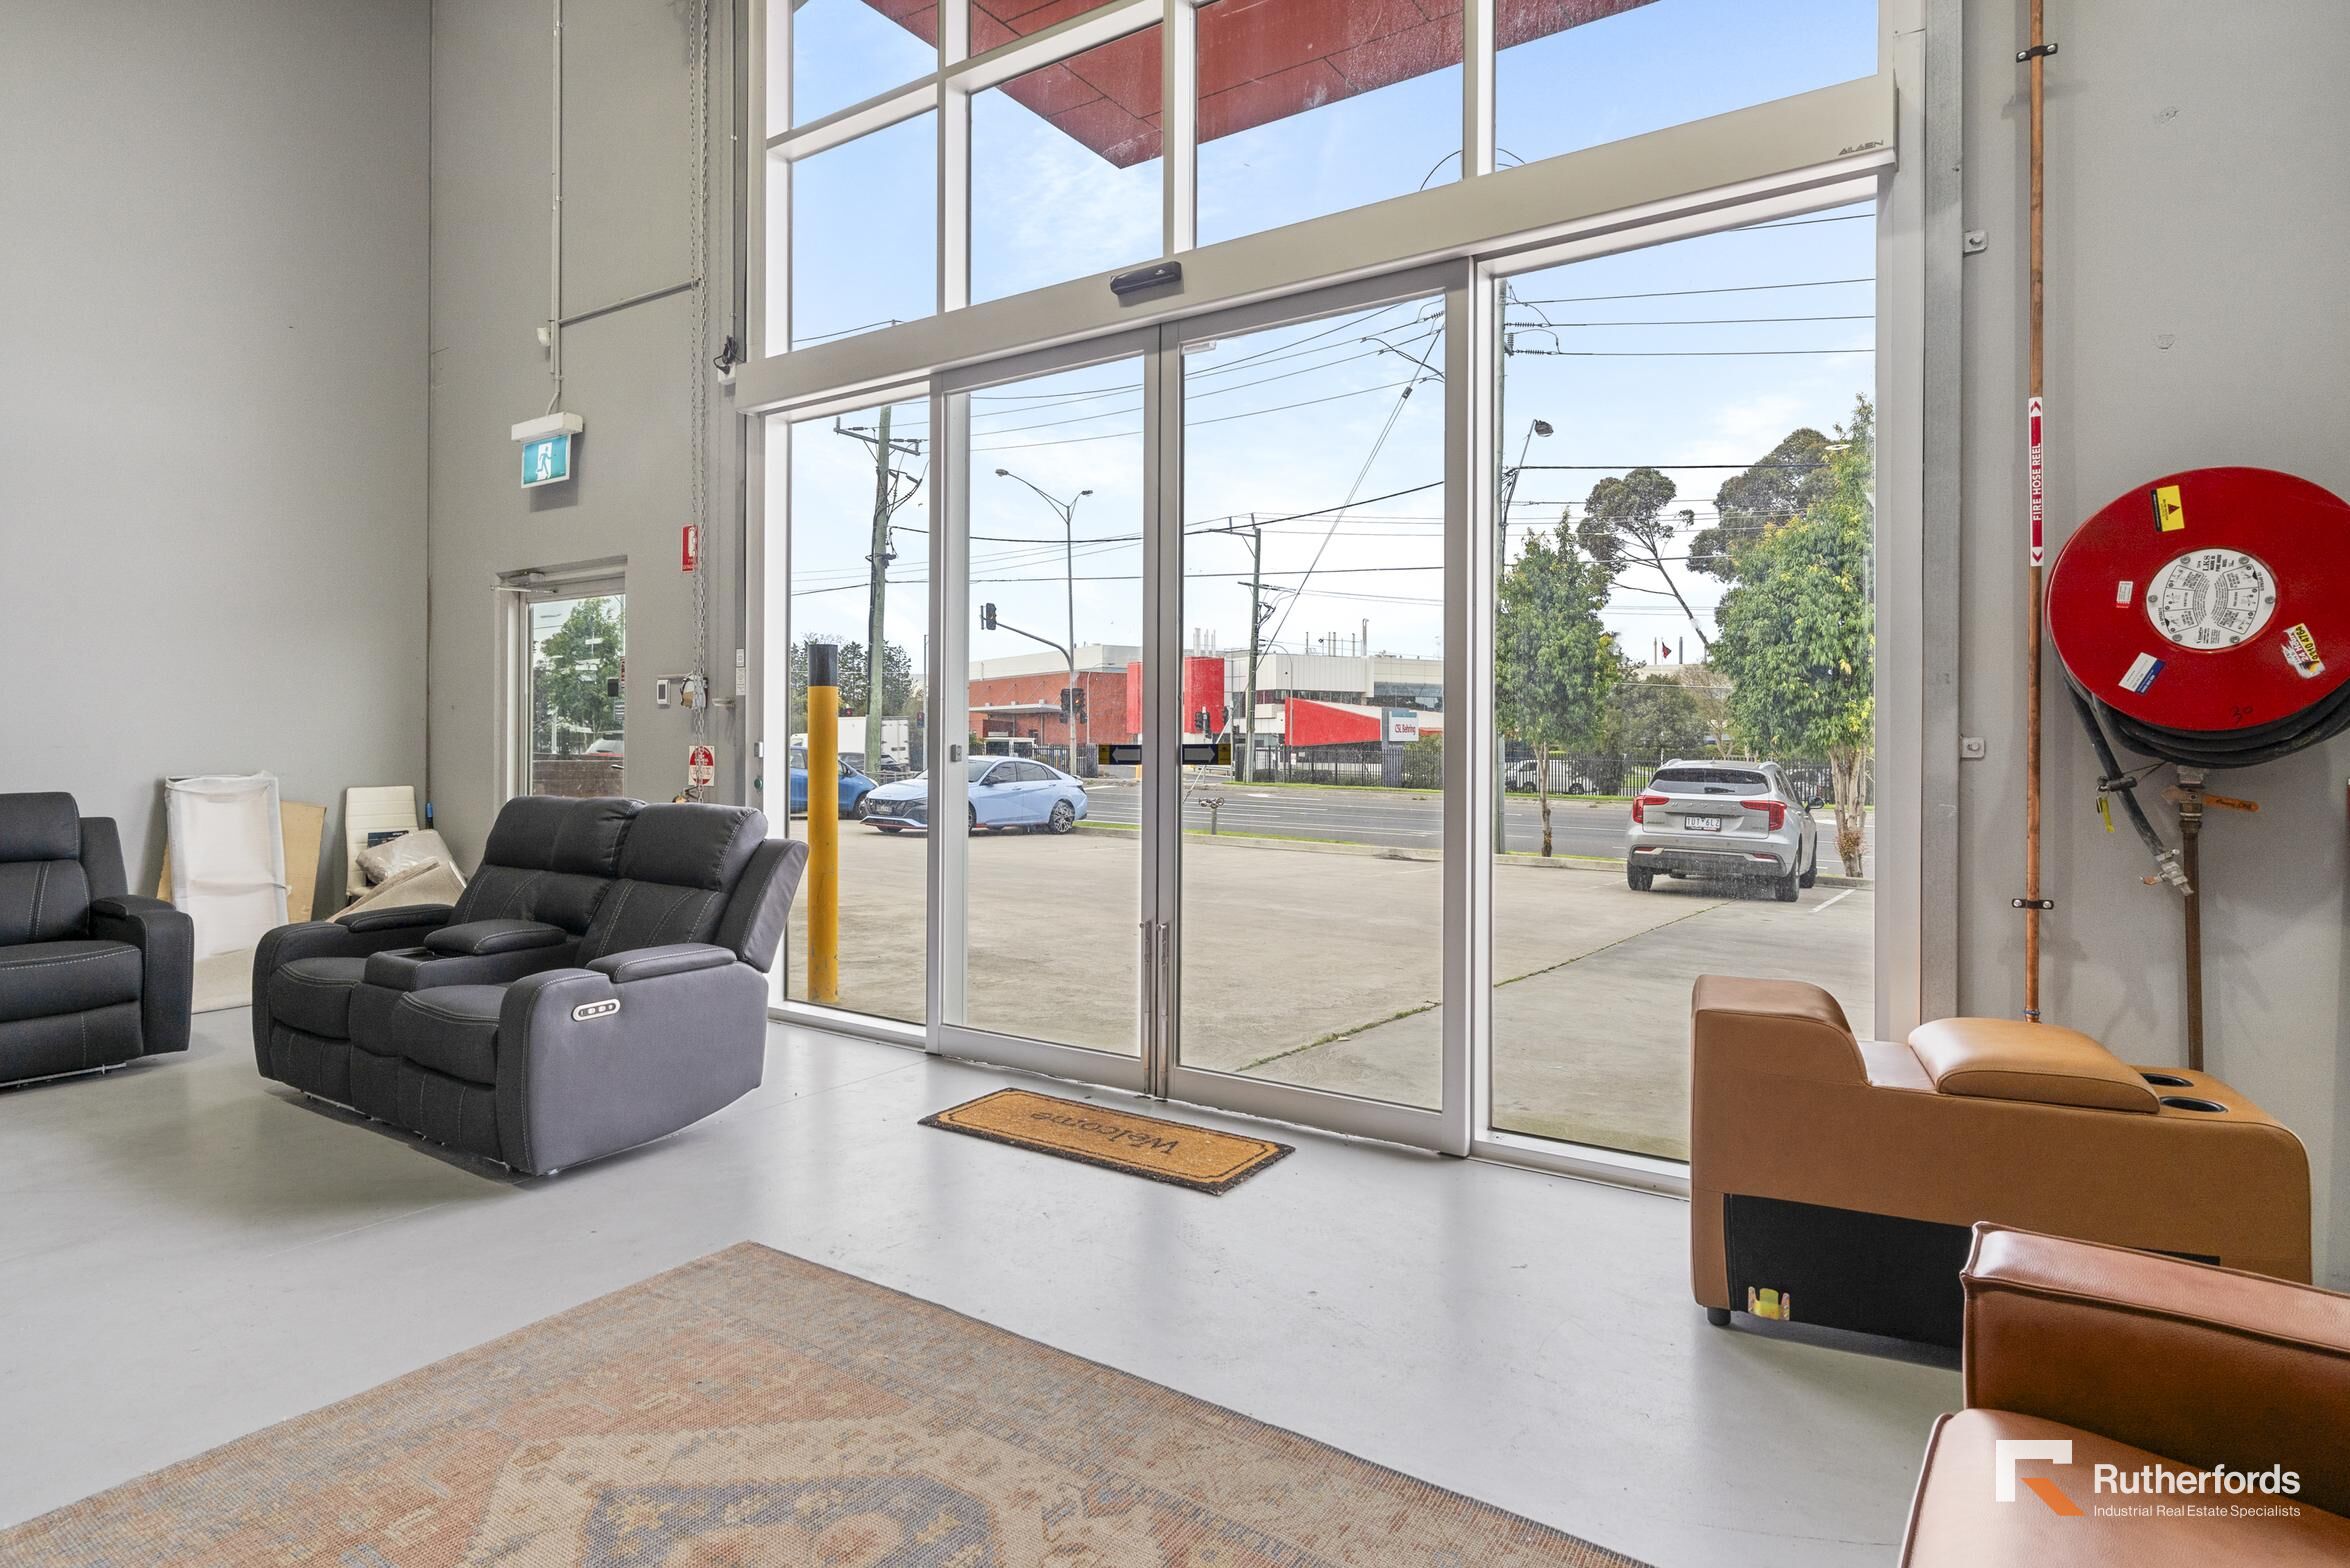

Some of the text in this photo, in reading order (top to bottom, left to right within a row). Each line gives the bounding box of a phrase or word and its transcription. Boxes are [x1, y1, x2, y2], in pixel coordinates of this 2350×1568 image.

[2031, 443, 2042, 521] FIRE HOSE REEL
[1030, 1111, 1180, 1155] Welcome
